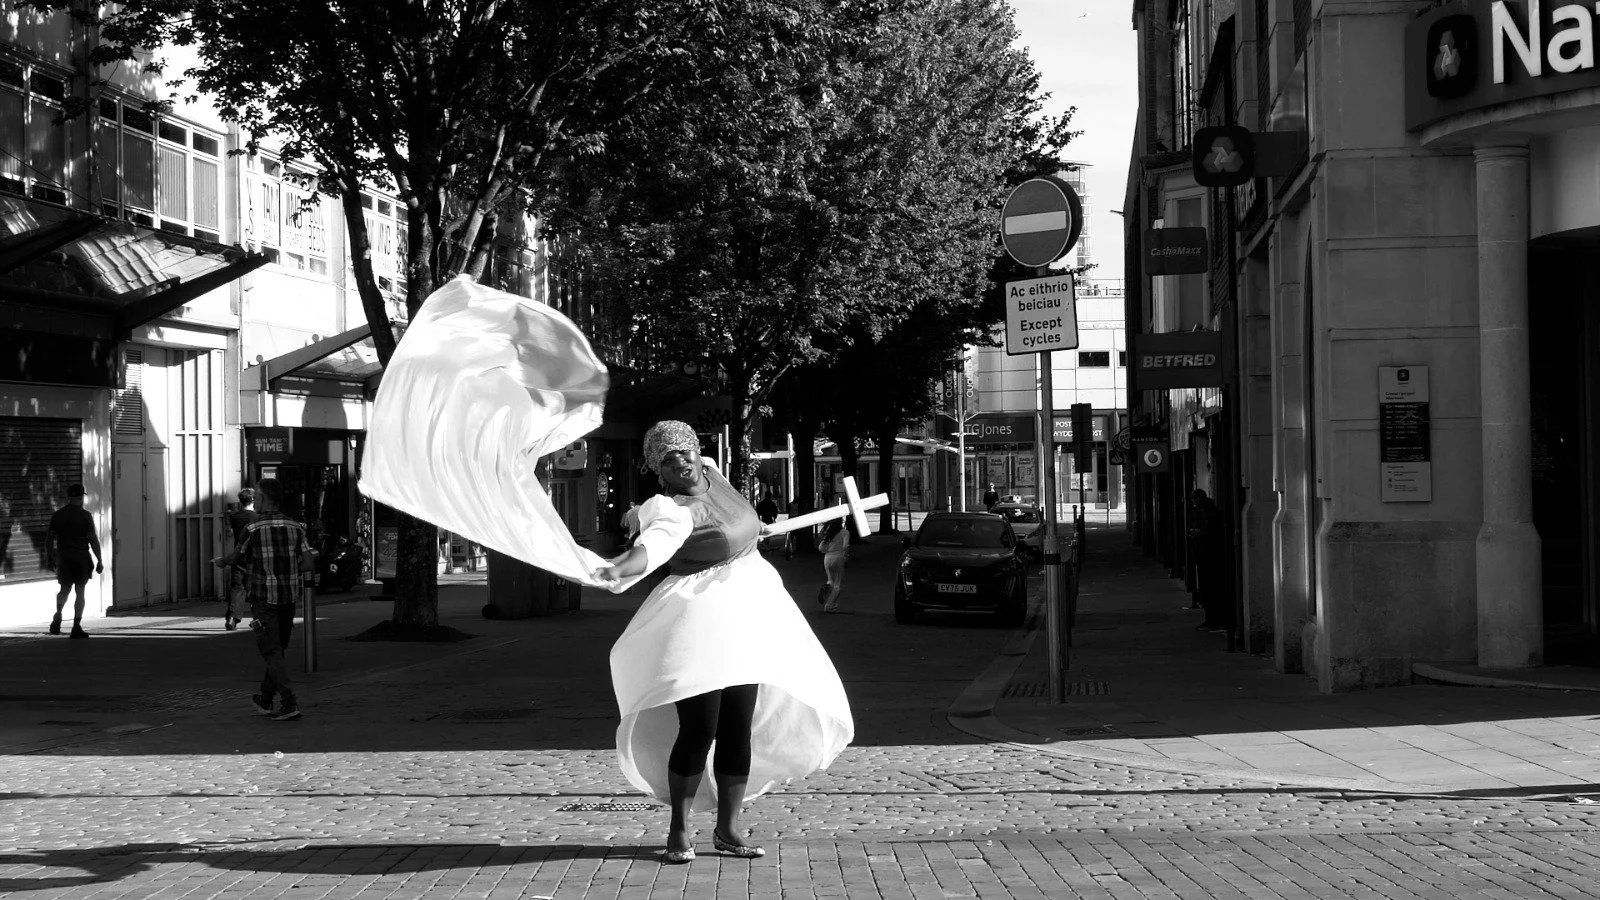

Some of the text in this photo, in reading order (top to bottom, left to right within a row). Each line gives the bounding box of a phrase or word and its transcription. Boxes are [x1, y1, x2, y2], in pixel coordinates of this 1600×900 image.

[1491, 0, 1600, 84] Na
[1010, 281, 1068, 298] Ac eithrio
[1018, 298, 1061, 312] beiciau
[1020, 316, 1062, 331] Except
[1022, 333, 1061, 347] cycles
[1142, 353, 1216, 368] BETFRED
[1055, 420, 1072, 428] POST
[255, 444, 283, 452] TIME
